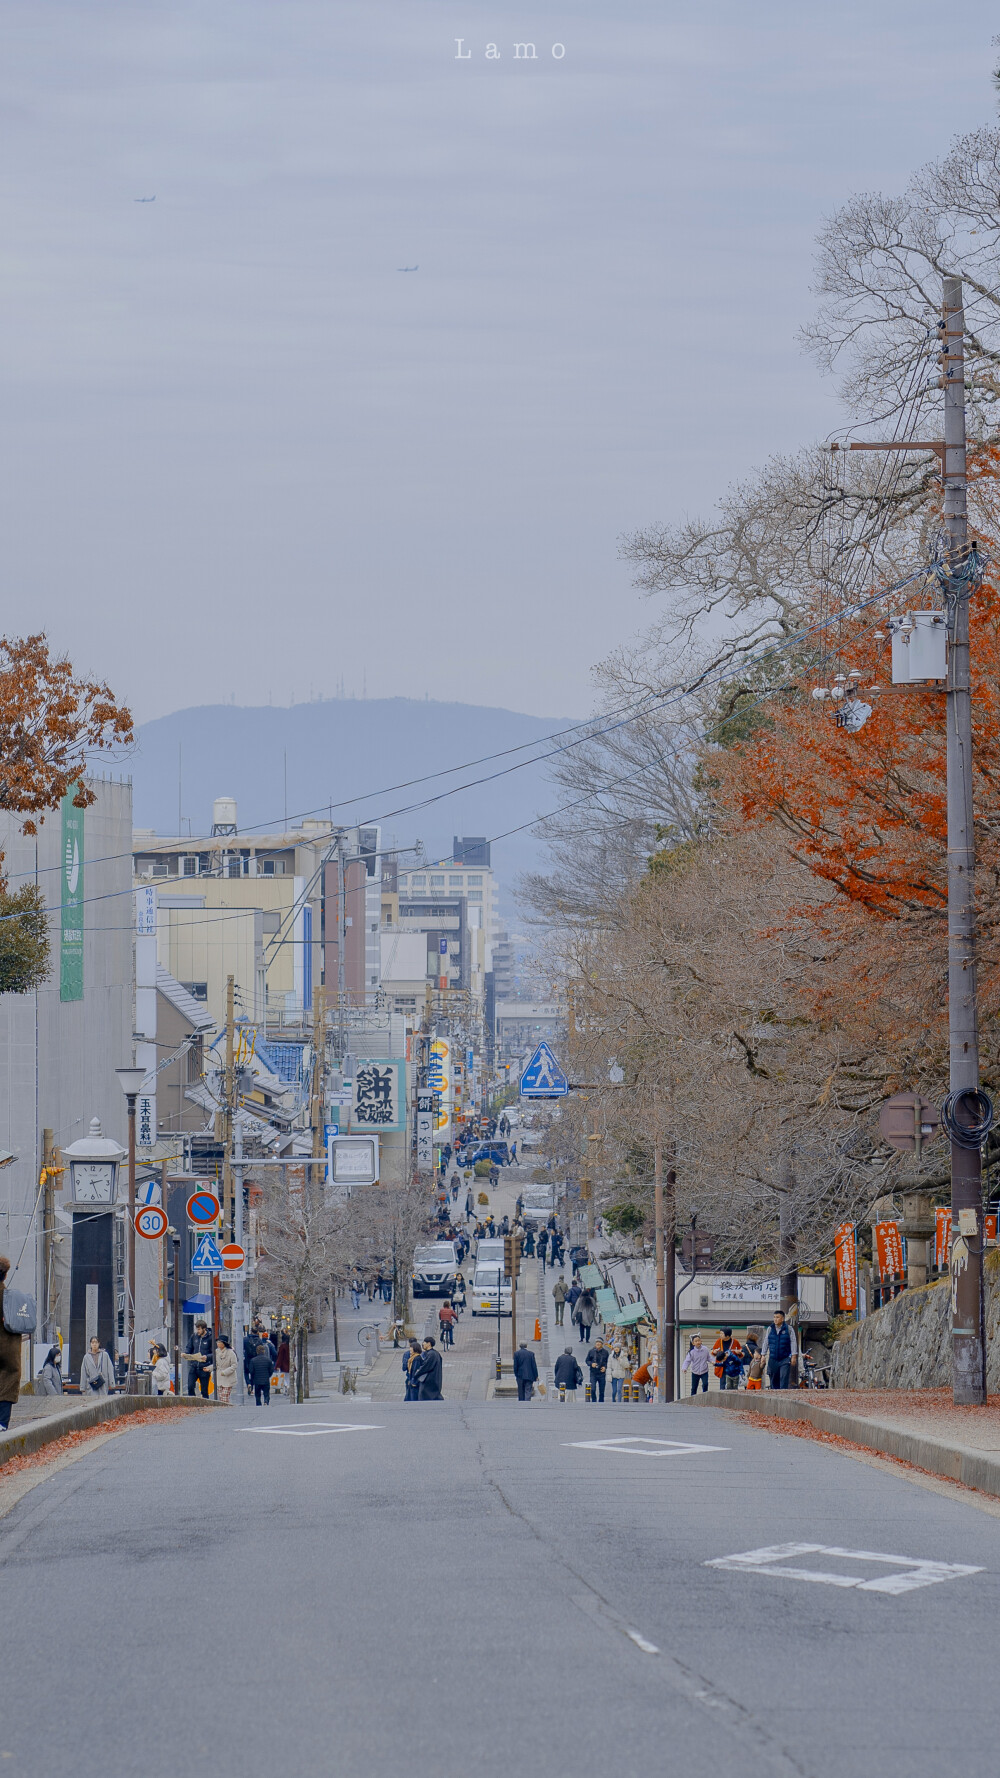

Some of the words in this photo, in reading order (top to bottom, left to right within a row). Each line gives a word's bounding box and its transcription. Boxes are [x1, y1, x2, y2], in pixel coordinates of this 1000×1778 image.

[145, 888, 154, 933] 時事通信社
[142, 1215, 161, 1231] 30
